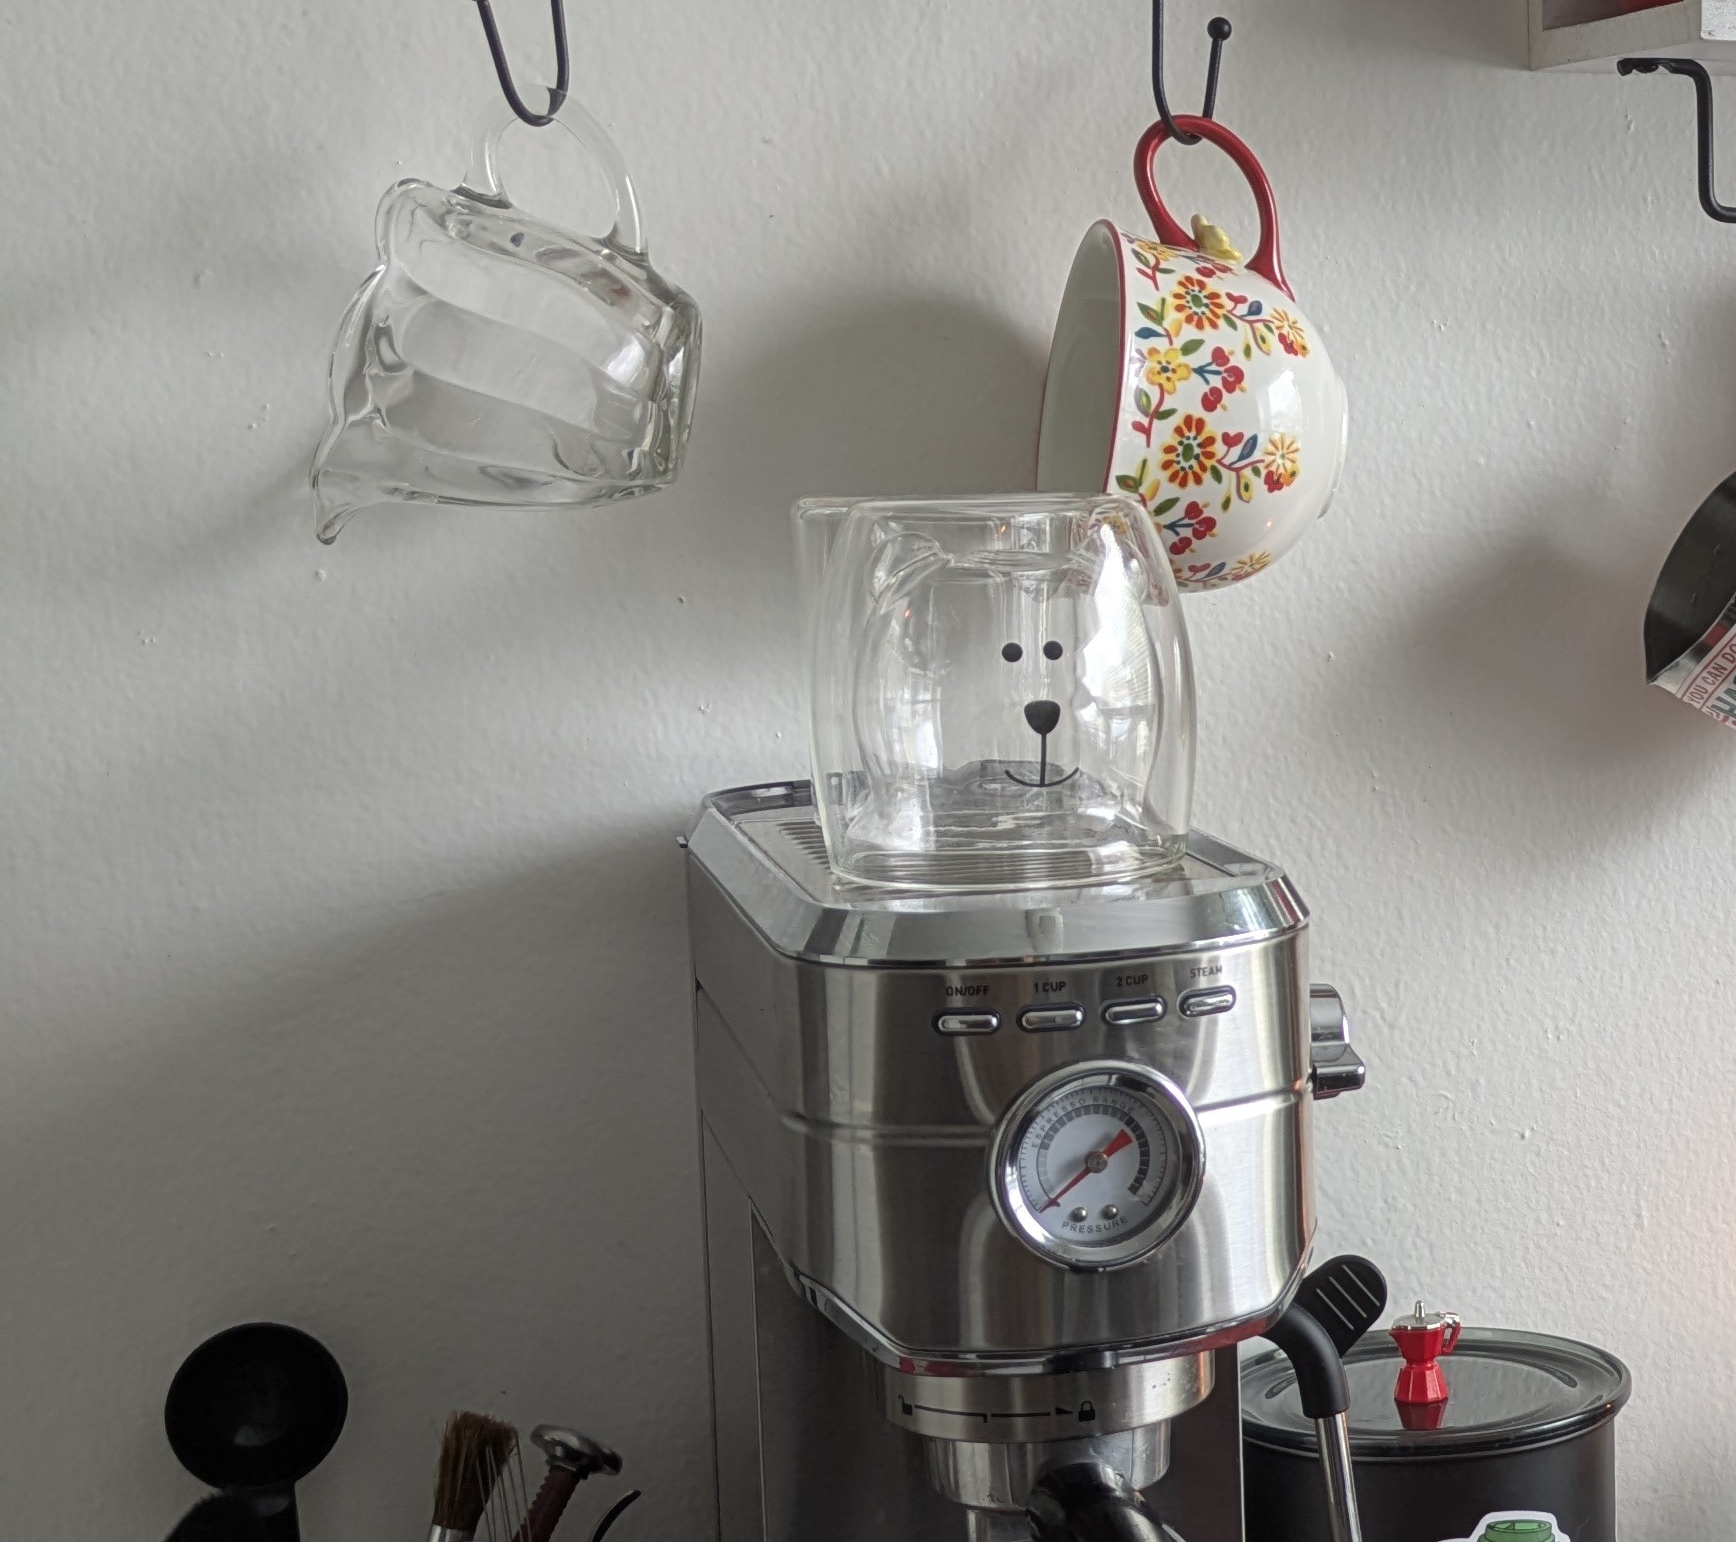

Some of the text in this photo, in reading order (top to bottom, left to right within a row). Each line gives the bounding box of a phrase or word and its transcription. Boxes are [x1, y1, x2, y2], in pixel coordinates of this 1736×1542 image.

[1686, 686, 1708, 707] YOU
[1702, 664, 1728, 685] CAN
[1190, 965, 1223, 979] STEAM
[1043, 980, 1066, 993] CUP
[1116, 974, 1149, 987] 2 CUP
[945, 984, 991, 997] ON/OFF
[1061, 1216, 1128, 1233] PRESSURE
